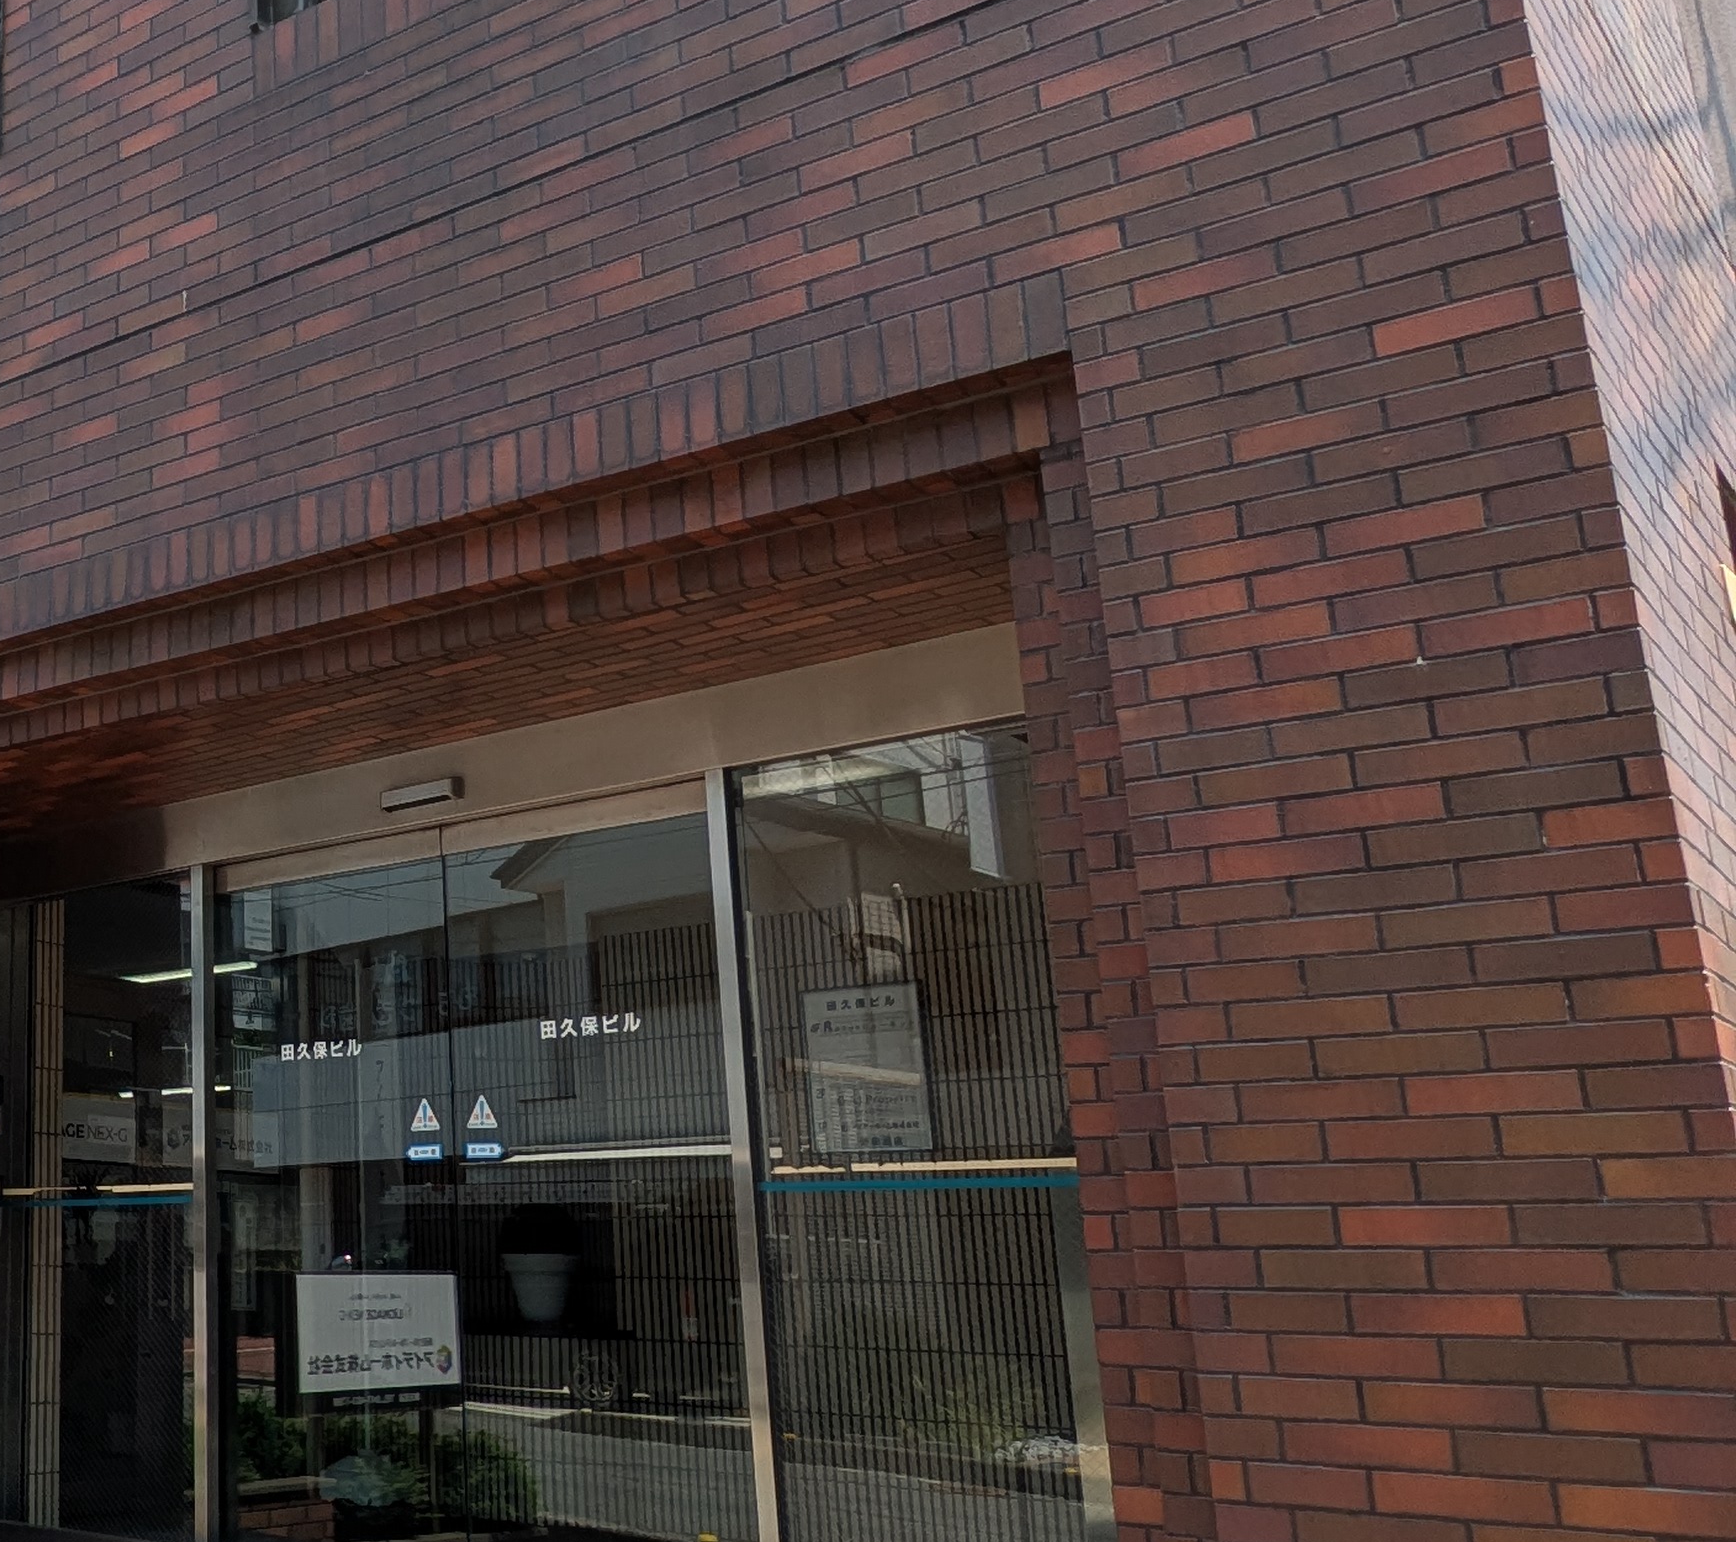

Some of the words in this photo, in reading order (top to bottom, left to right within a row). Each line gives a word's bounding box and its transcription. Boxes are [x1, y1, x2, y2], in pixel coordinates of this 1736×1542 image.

[540, 1012, 641, 1040] 田久保ビル
[280, 1039, 362, 1062] 田久保ビル
